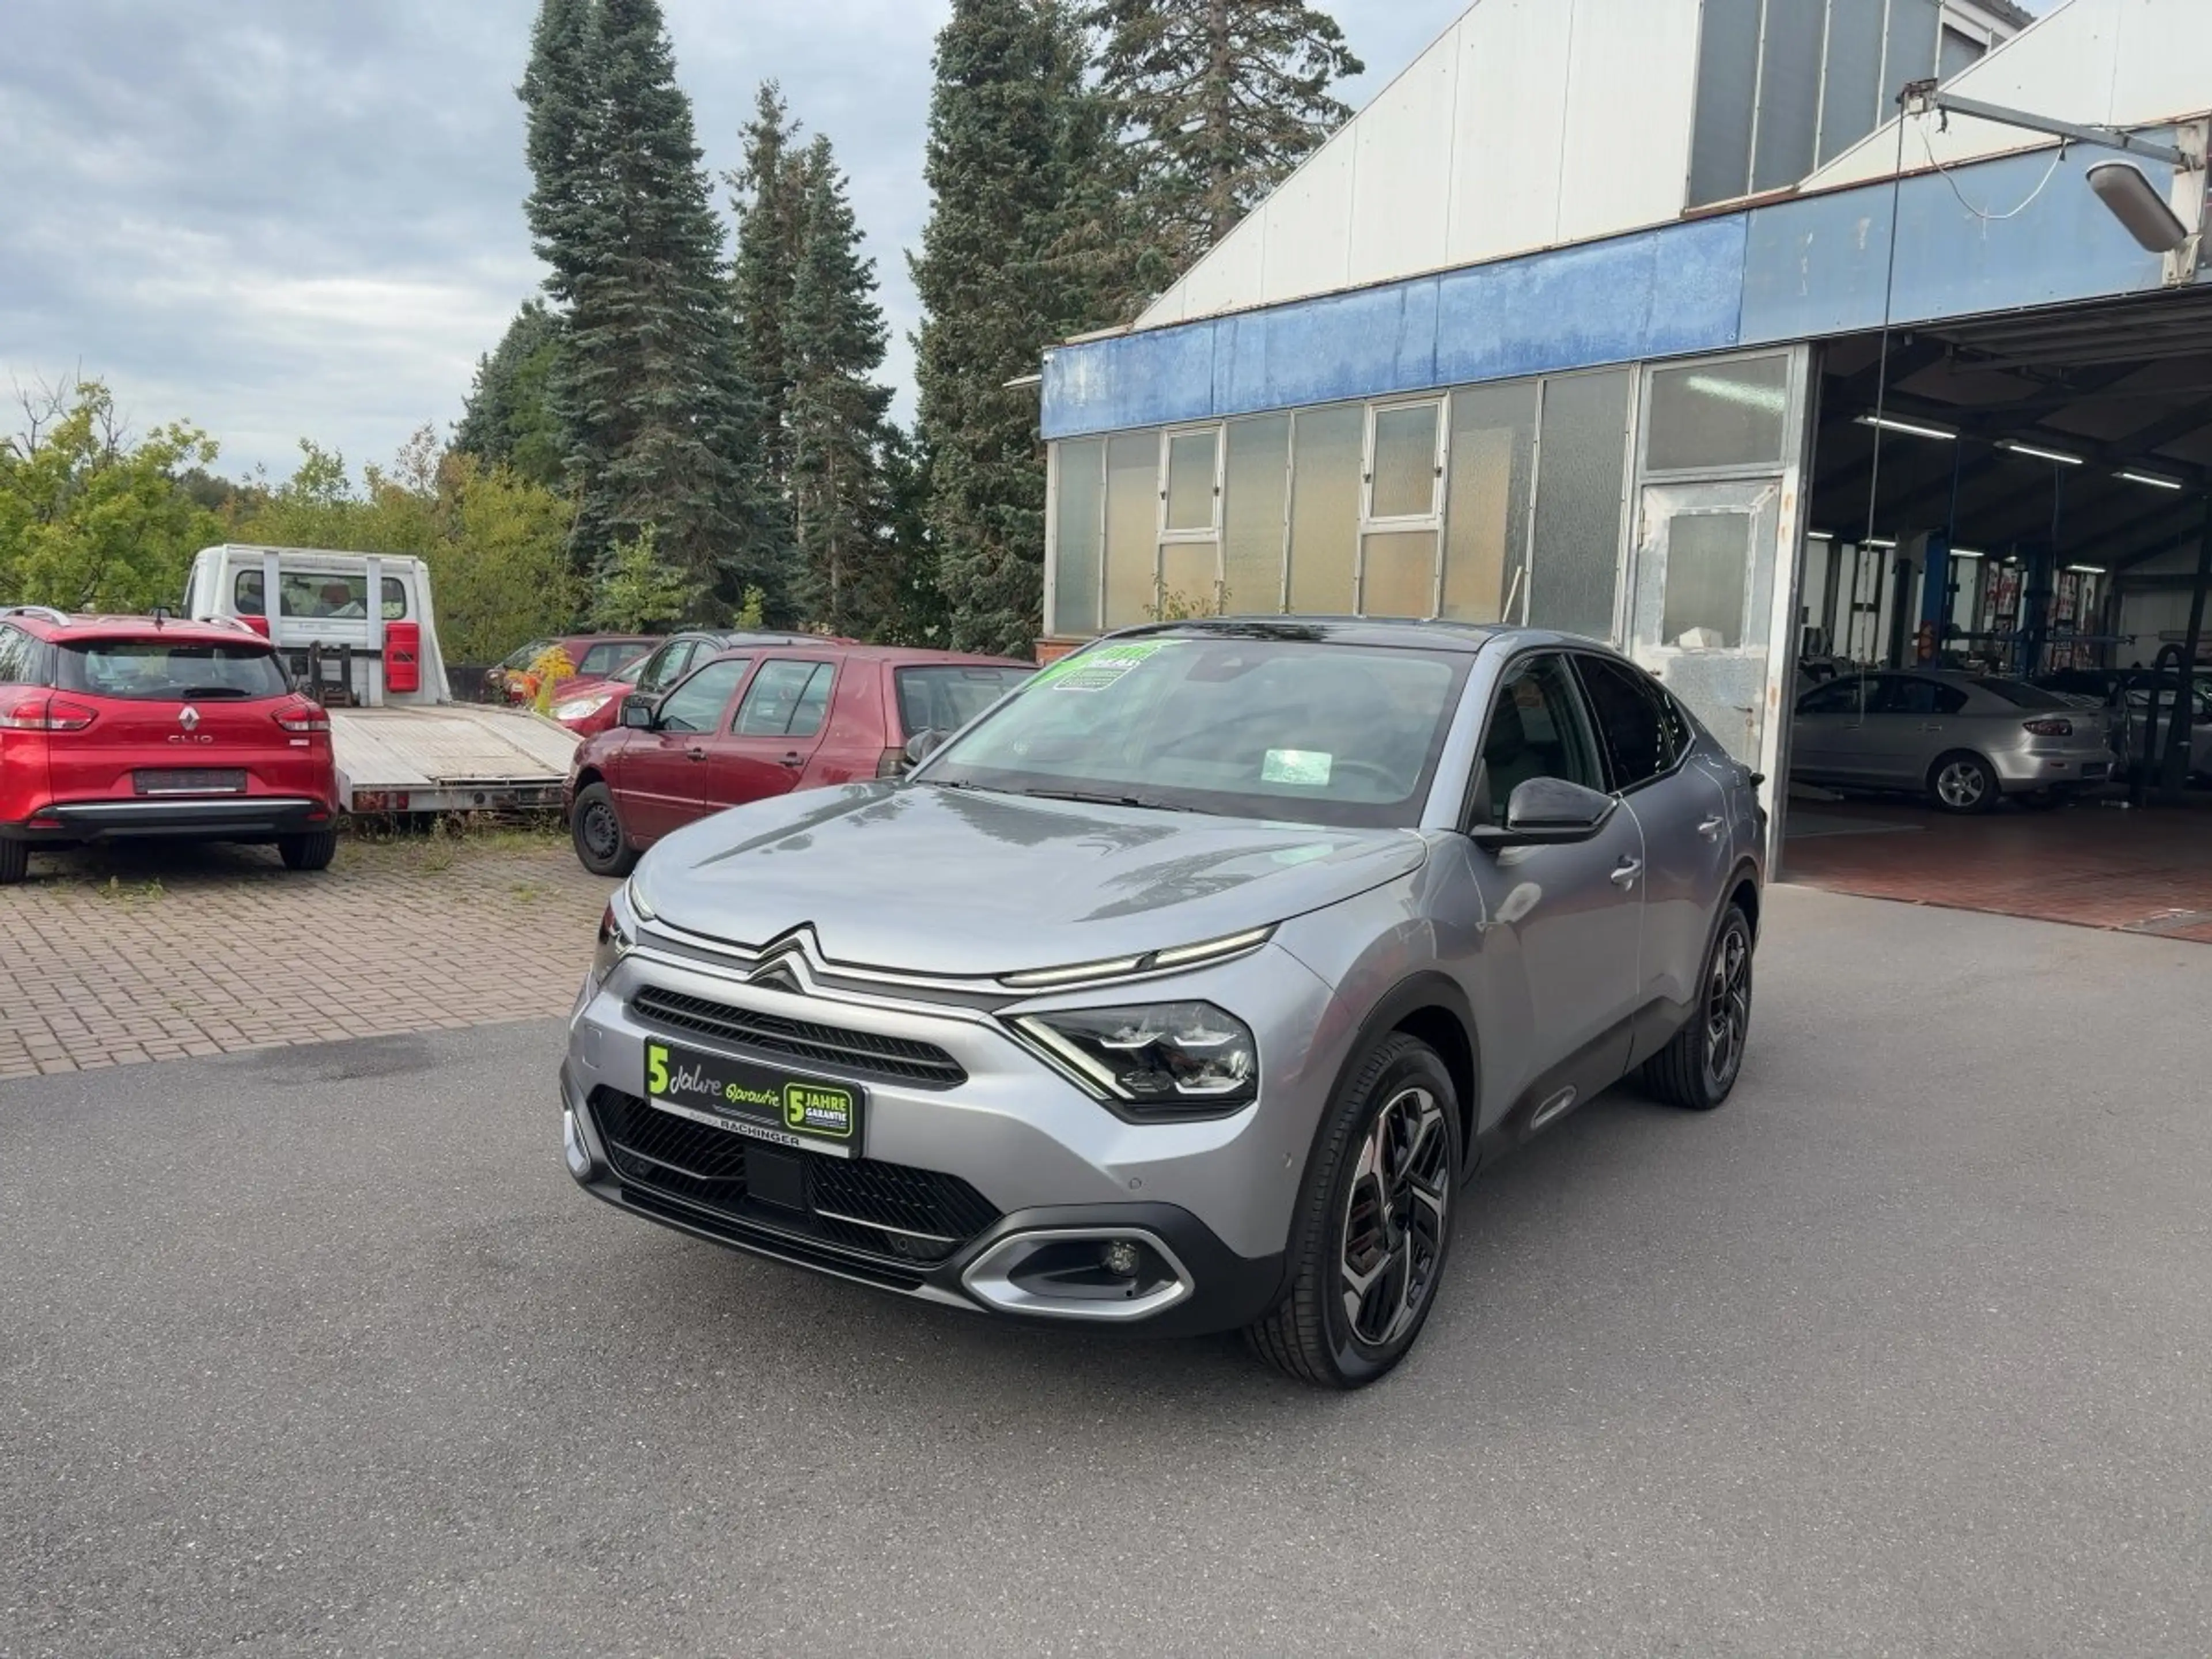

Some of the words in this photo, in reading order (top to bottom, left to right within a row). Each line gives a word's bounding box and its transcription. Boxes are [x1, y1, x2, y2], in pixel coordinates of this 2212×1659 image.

[168, 734, 213, 744] CLIO
[649, 1044, 669, 1094] 5
[669, 1063, 722, 1094] Jahre
[725, 1082, 780, 1107] Garantie
[790, 1090, 805, 1122] 5
[805, 1093, 847, 1112] JAHRE
[805, 1107, 847, 1122] GARANTIE
[720, 1120, 800, 1146] RACHINGER
